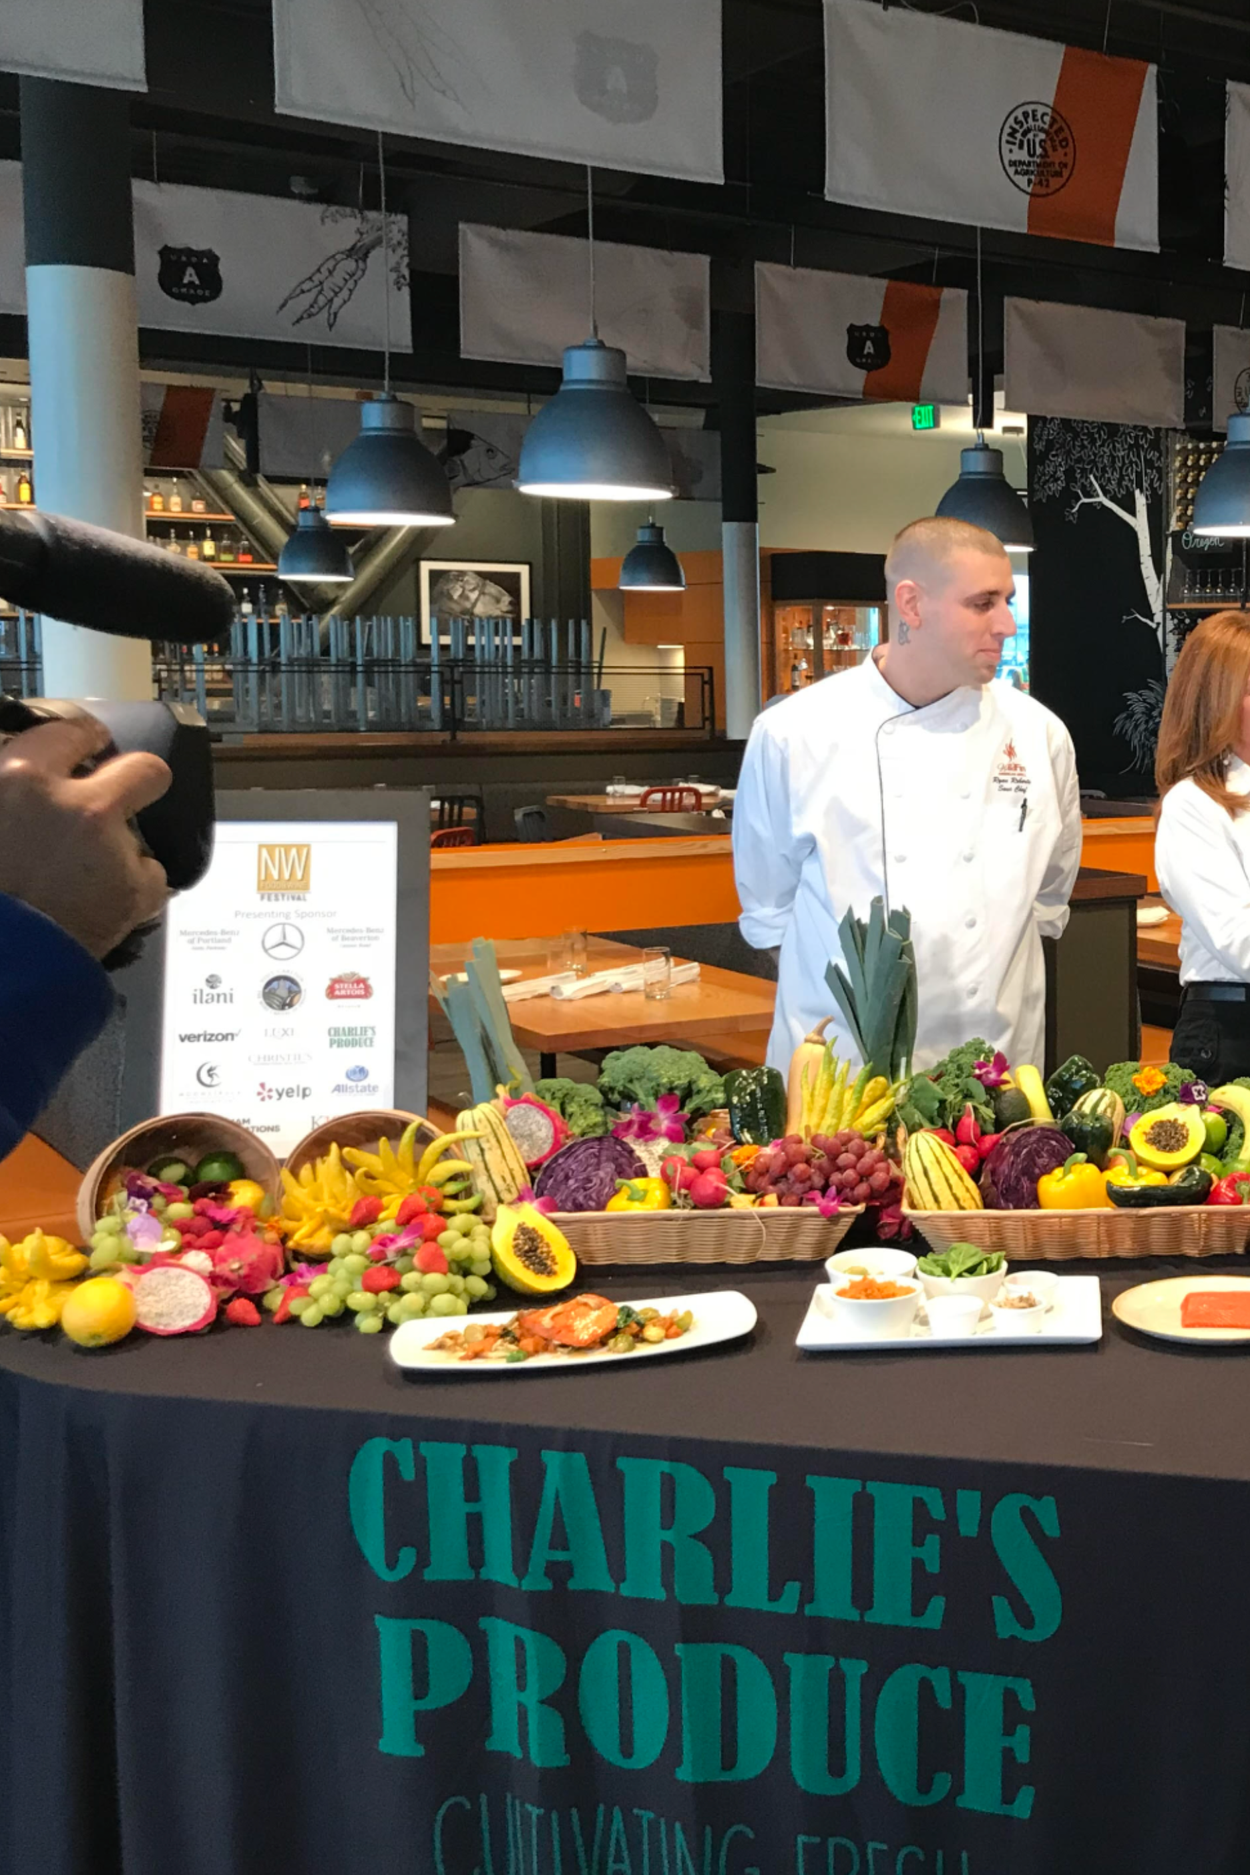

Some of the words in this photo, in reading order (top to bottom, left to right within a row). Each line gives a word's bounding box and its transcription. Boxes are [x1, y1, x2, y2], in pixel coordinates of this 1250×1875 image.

[1005, 109, 1069, 149] INSPECTED
[183, 266, 200, 285] A
[863, 340, 875, 355] A
[915, 405, 934, 429] EXIT
[1182, 532, 1224, 550] Oregon
[260, 847, 309, 880] NW
[260, 893, 308, 902] FESTIVAL
[234, 910, 291, 920] Presenting
[294, 909, 337, 919] Sponsor
[192, 988, 234, 1004] ilani
[178, 1031, 235, 1043] verizon
[328, 1026, 376, 1037] CHARLIE'S
[329, 1037, 374, 1048] PRODUCE
[275, 1085, 312, 1100] yelp
[332, 1084, 379, 1094] Allstate
[348, 1436, 1063, 1642] CHARLIE'S
[374, 1614, 1036, 1819] PRODUCE
